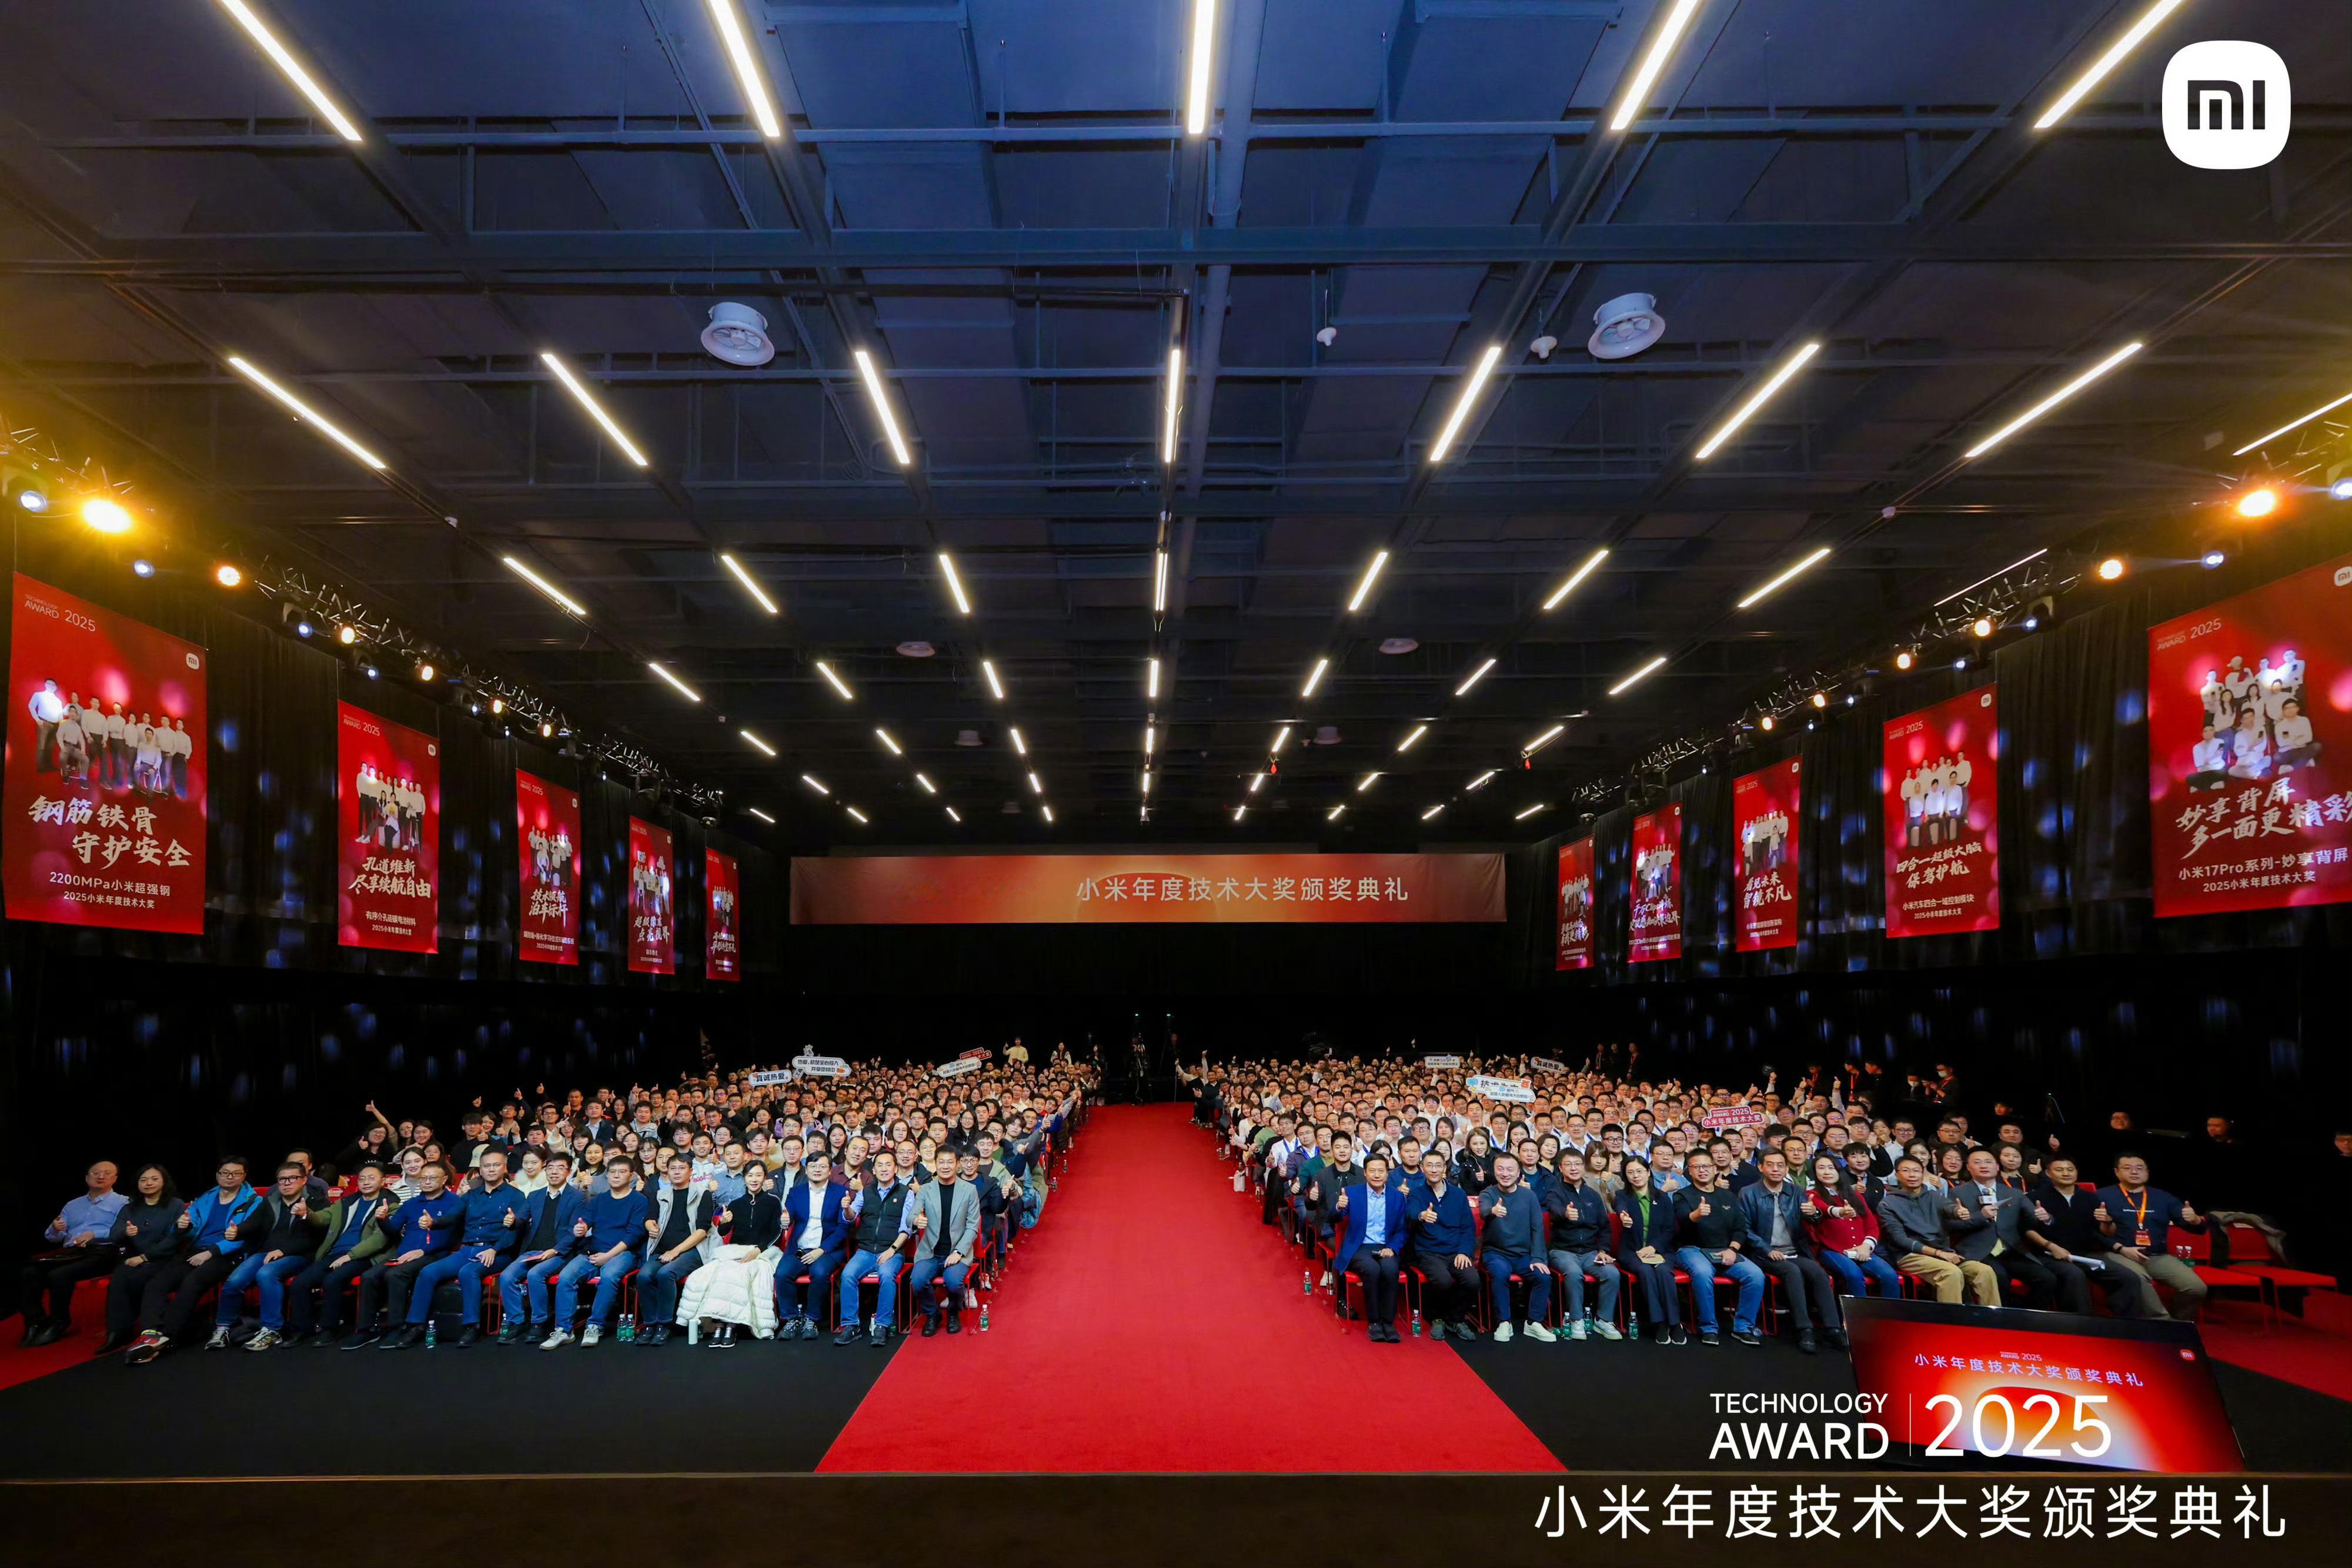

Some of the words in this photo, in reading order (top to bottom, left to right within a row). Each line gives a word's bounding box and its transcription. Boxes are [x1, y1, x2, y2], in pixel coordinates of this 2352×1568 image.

[25, 600, 59, 618] AWARD
[65, 610, 95, 631] 2025
[2190, 618, 2221, 638] 2025
[363, 722, 380, 736] 2025
[1906, 721, 1923, 734] 2025
[28, 795, 158, 835] 钢筋铁骨
[2176, 777, 2296, 832] 妙享背屏
[2180, 790, 2352, 860] 多一面更精彩
[72, 831, 193, 870] 守护安全
[1896, 842, 1982, 874] 四合一超级大脑
[362, 857, 416, 878] 孔道维新
[1906, 860, 1970, 889] 保驾护航
[2179, 847, 2348, 880] 小米17Pro系列-妙享背屏
[49, 872, 171, 898] 2200MPa小米超强钢
[348, 874, 432, 899] 尽享续航自由
[1077, 877, 1408, 901] 小米年度技术大奖颁奖典礼
[1743, 871, 1782, 893] 看见未来
[2203, 870, 2316, 892] 2025小米年度技术大奖
[64, 891, 155, 910] 2025小米年度技术大奖
[756, 1072, 785, 1082] 真诚热爱
[1704, 1114, 1762, 1126] 小米年度技术大奖
[2022, 1352, 2042, 1362] 2025
[1915, 1353, 2143, 1387] 小米年度技术大奖颁奖典礼
